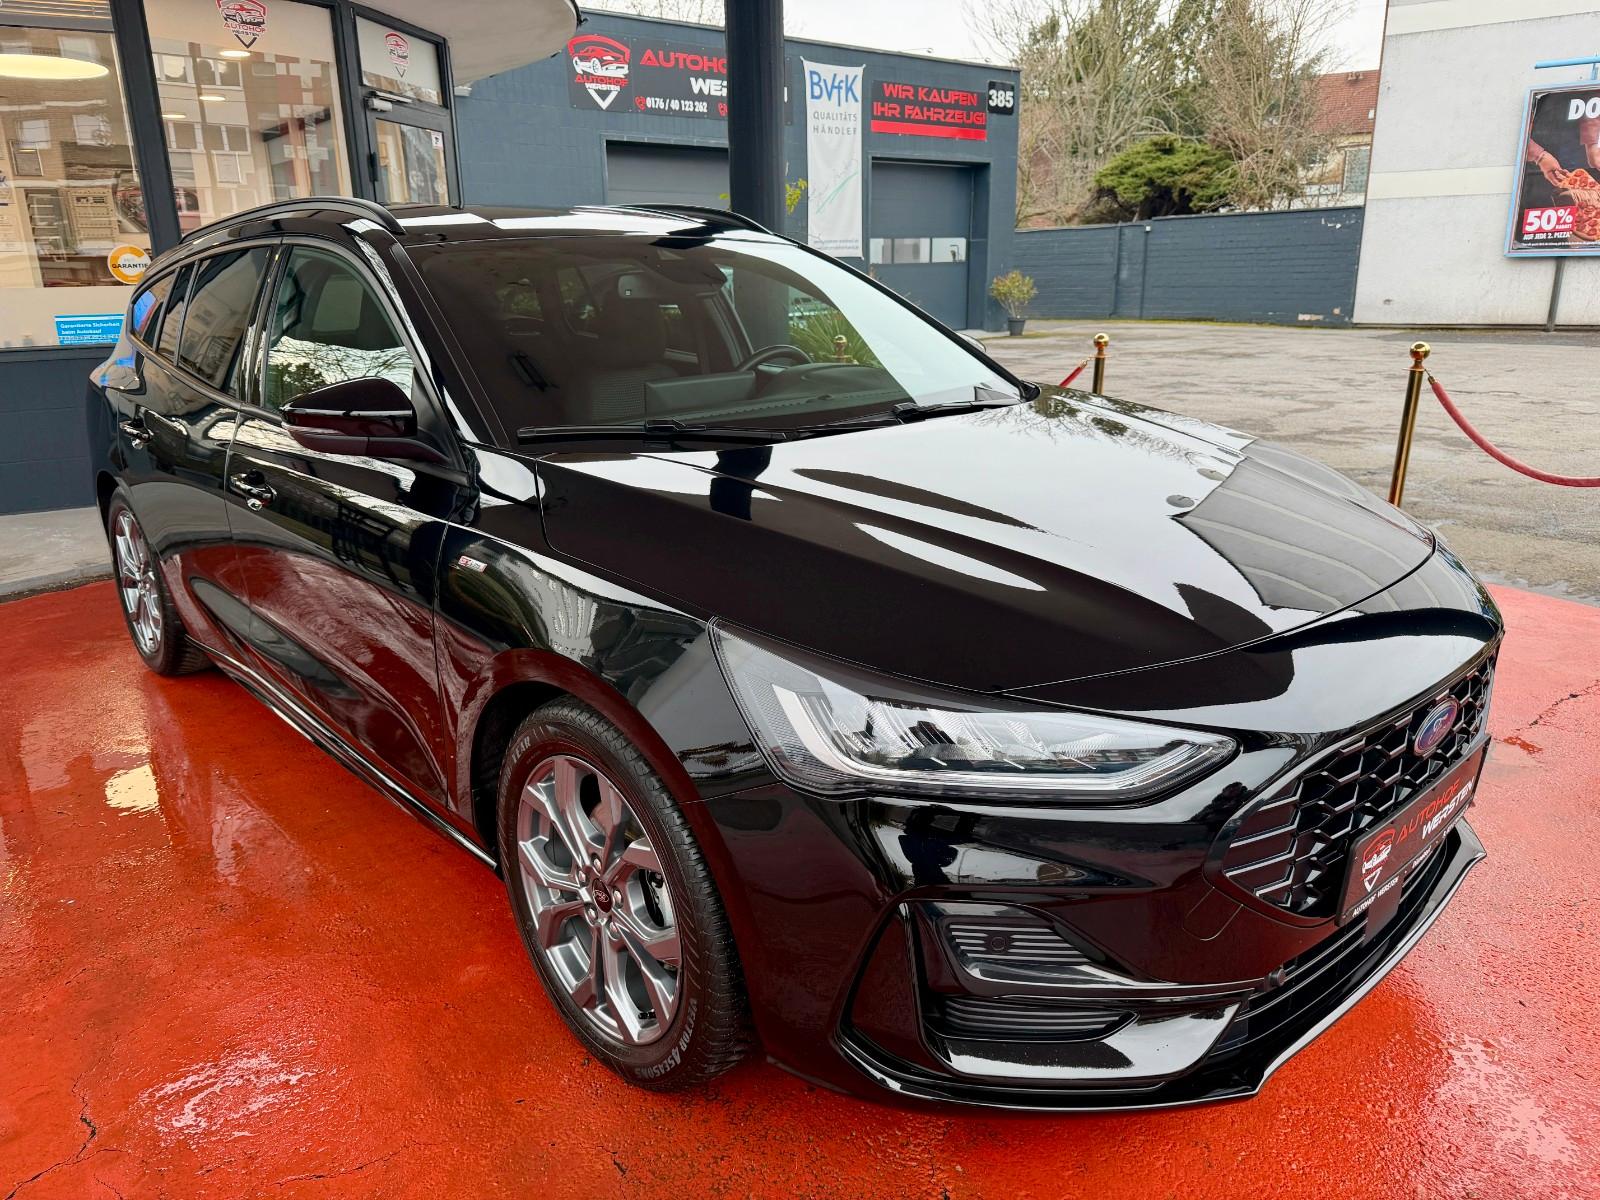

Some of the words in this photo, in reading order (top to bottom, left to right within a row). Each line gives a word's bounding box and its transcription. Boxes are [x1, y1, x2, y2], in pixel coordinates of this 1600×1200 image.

[575, 74, 629, 87] AUTOHOF
[809, 70, 859, 107] BVfK
[882, 82, 914, 100] WIR
[917, 87, 977, 106] KAUFEN
[988, 89, 1014, 108] 385
[645, 96, 665, 109] 0176
[669, 99, 680, 111] 40
[681, 100, 694, 112] 123
[694, 101, 708, 113] 262
[873, 101, 900, 118] IHR
[813, 110, 858, 121] QUALITÄTS
[812, 124, 858, 136] HÄNDLER
[1525, 208, 1574, 232] 50%
[1422, 776, 1475, 840] WERSTEN
